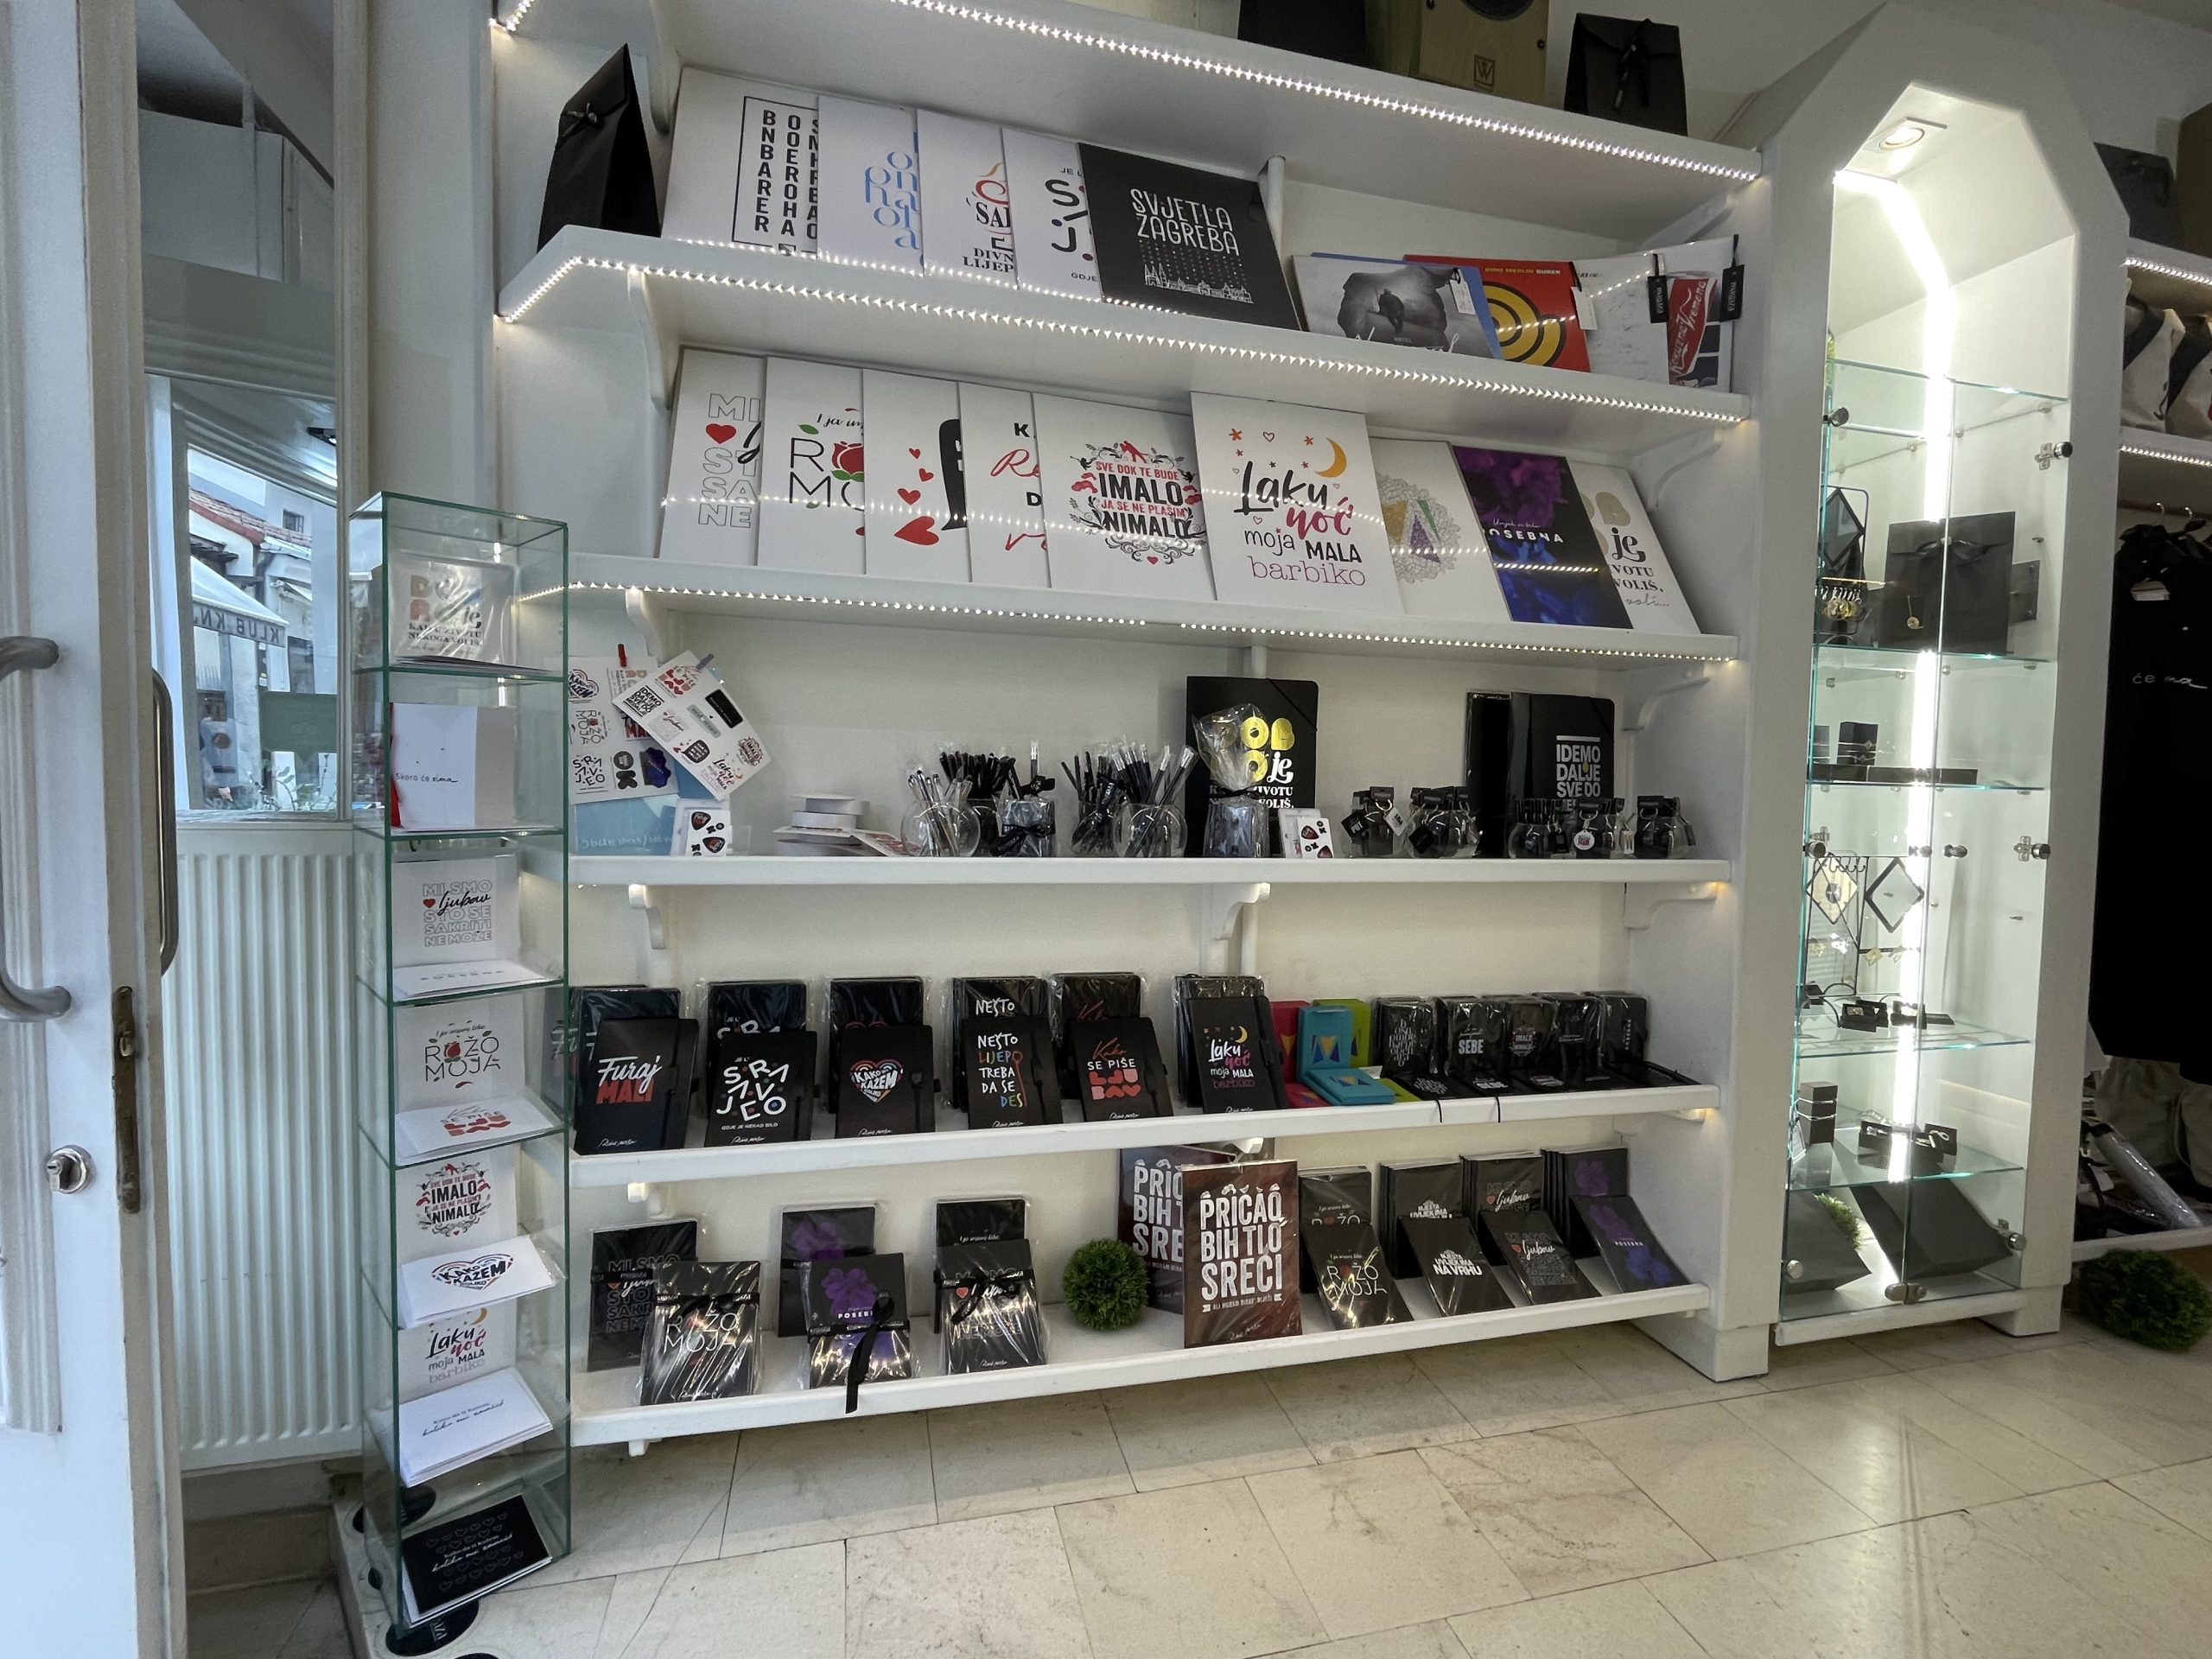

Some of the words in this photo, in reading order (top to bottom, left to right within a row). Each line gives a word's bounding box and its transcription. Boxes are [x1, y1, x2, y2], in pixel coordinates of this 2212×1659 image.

[1130, 188, 1234, 232] SVJETLA
[1136, 213, 1241, 257] ZAGREBA
[1071, 272, 1098, 283] GDJE
[709, 393, 761, 423] MI
[1096, 461, 1114, 473] SVE
[1117, 465, 1136, 476] DOK
[1140, 467, 1151, 477] TE
[1154, 469, 1179, 480] BUDE
[1099, 473, 1184, 506] IMALO
[1234, 461, 1328, 516] Laku
[698, 503, 753, 528] NE
[1101, 499, 1114, 510] JA
[1117, 501, 1128, 512] SE
[1132, 504, 1146, 513] NE
[1148, 504, 1185, 518] PLAŠIM
[1287, 497, 1354, 540] noć
[1103, 511, 1190, 539] NIMALO
[1484, 528, 1564, 543] OSEBNA
[1244, 529, 1296, 556] moja
[1306, 540, 1363, 563] MALA
[1611, 527, 1647, 563] je
[1247, 556, 1366, 587] barbiko
[1611, 564, 1654, 577] VOTU
[1556, 744, 1601, 763] IDEMO
[1267, 752, 1294, 784] je
[1556, 763, 1601, 782] DALJE
[1254, 785, 1294, 797] IVOTU
[1556, 781, 1583, 798] SVE
[1584, 781, 1601, 798] DO
[423, 882, 446, 897] MI
[449, 880, 493, 895] SMO
[468, 905, 492, 918] SE
[425, 919, 492, 935] SAKRITI
[425, 933, 448, 947] NE
[978, 1050, 1023, 1065] LIJEPO
[1208, 1039, 1242, 1063] Laku
[425, 1055, 501, 1082] MOJA
[598, 1055, 663, 1094] Furaj
[979, 1066, 1015, 1079] TREBA
[1087, 1061, 1103, 1071] SE
[1109, 1058, 1136, 1069] PIŠE
[1211, 1067, 1230, 1078] moja
[1232, 1068, 1254, 1078] MALA
[596, 1078, 656, 1104] MALI
[982, 1082, 997, 1093] DA
[1001, 1080, 1016, 1093] SE
[431, 1180, 478, 1205] IMALO
[431, 1203, 480, 1224] NIMALO
[1134, 1194, 1171, 1227] BIH
[1200, 1228, 1239, 1262] BIH
[1243, 1224, 1263, 1255] TI
[1201, 1244, 1282, 1301] SREĆI
[1433, 1264, 1451, 1275] NA
[1452, 1266, 1483, 1276] VRHU
[838, 1311, 874, 1319] POSEB
[425, 1328, 475, 1360] Laku
[429, 1355, 454, 1371] moja
[458, 1349, 486, 1364] MALA
